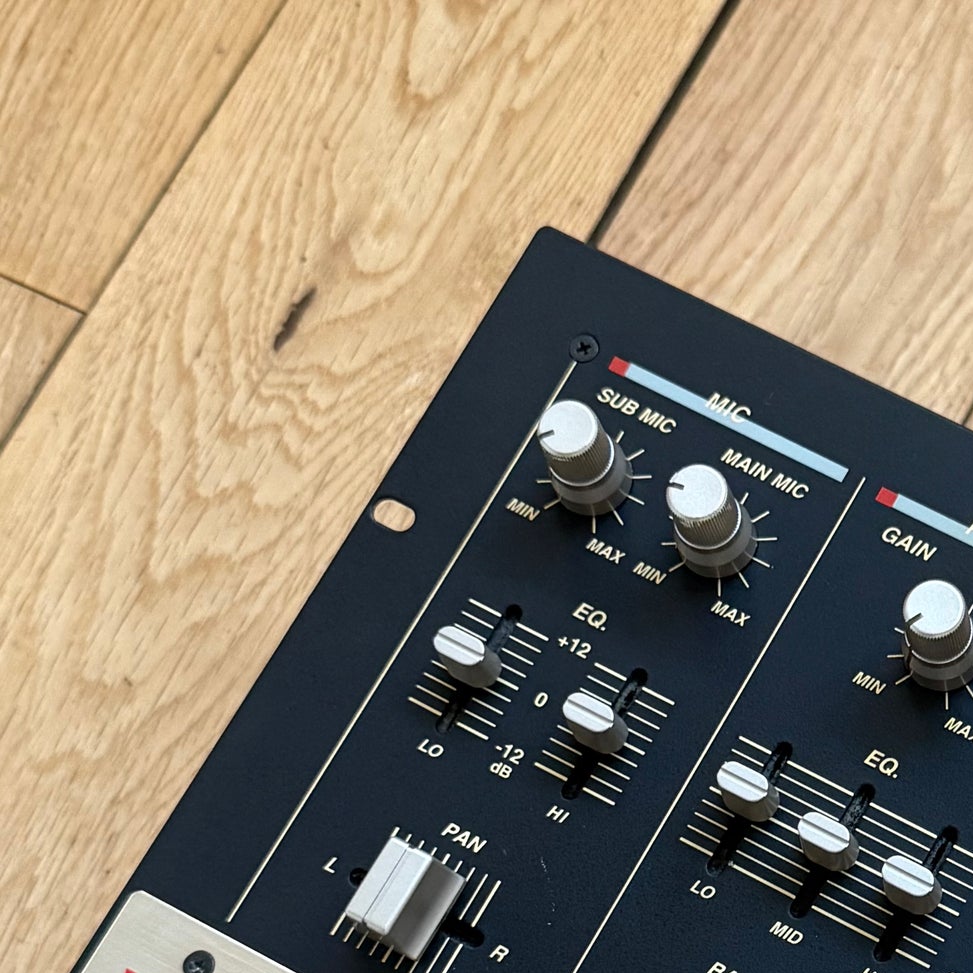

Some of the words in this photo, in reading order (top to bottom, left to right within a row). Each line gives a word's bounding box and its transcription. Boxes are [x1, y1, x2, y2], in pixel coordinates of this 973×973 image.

[597, 387, 638, 417] SUB
[638, 407, 677, 434] MIC
[705, 392, 752, 423] MIC
[720, 448, 769, 482] MAIN
[770, 473, 809, 499] MIC
[506, 498, 540, 521] MIN
[586, 538, 626, 565] MAX
[881, 526, 937, 562] GAIN
[633, 562, 667, 584] MIN
[572, 602, 608, 630] EQ.
[710, 601, 751, 627] MAX
[557, 636, 592, 659] +12
[852, 671, 886, 695] MIN
[534, 692, 549, 708] 0
[417, 739, 444, 759] LO
[495, 743, 525, 765] -12
[490, 761, 512, 779] dB
[863, 748, 900, 779] EQ.
[546, 805, 570, 824] HI
[441, 822, 487, 854] PAN
[323, 856, 338, 874] L
[690, 880, 717, 901] LO
[769, 921, 804, 945] MID
[489, 943, 510, 963] R
